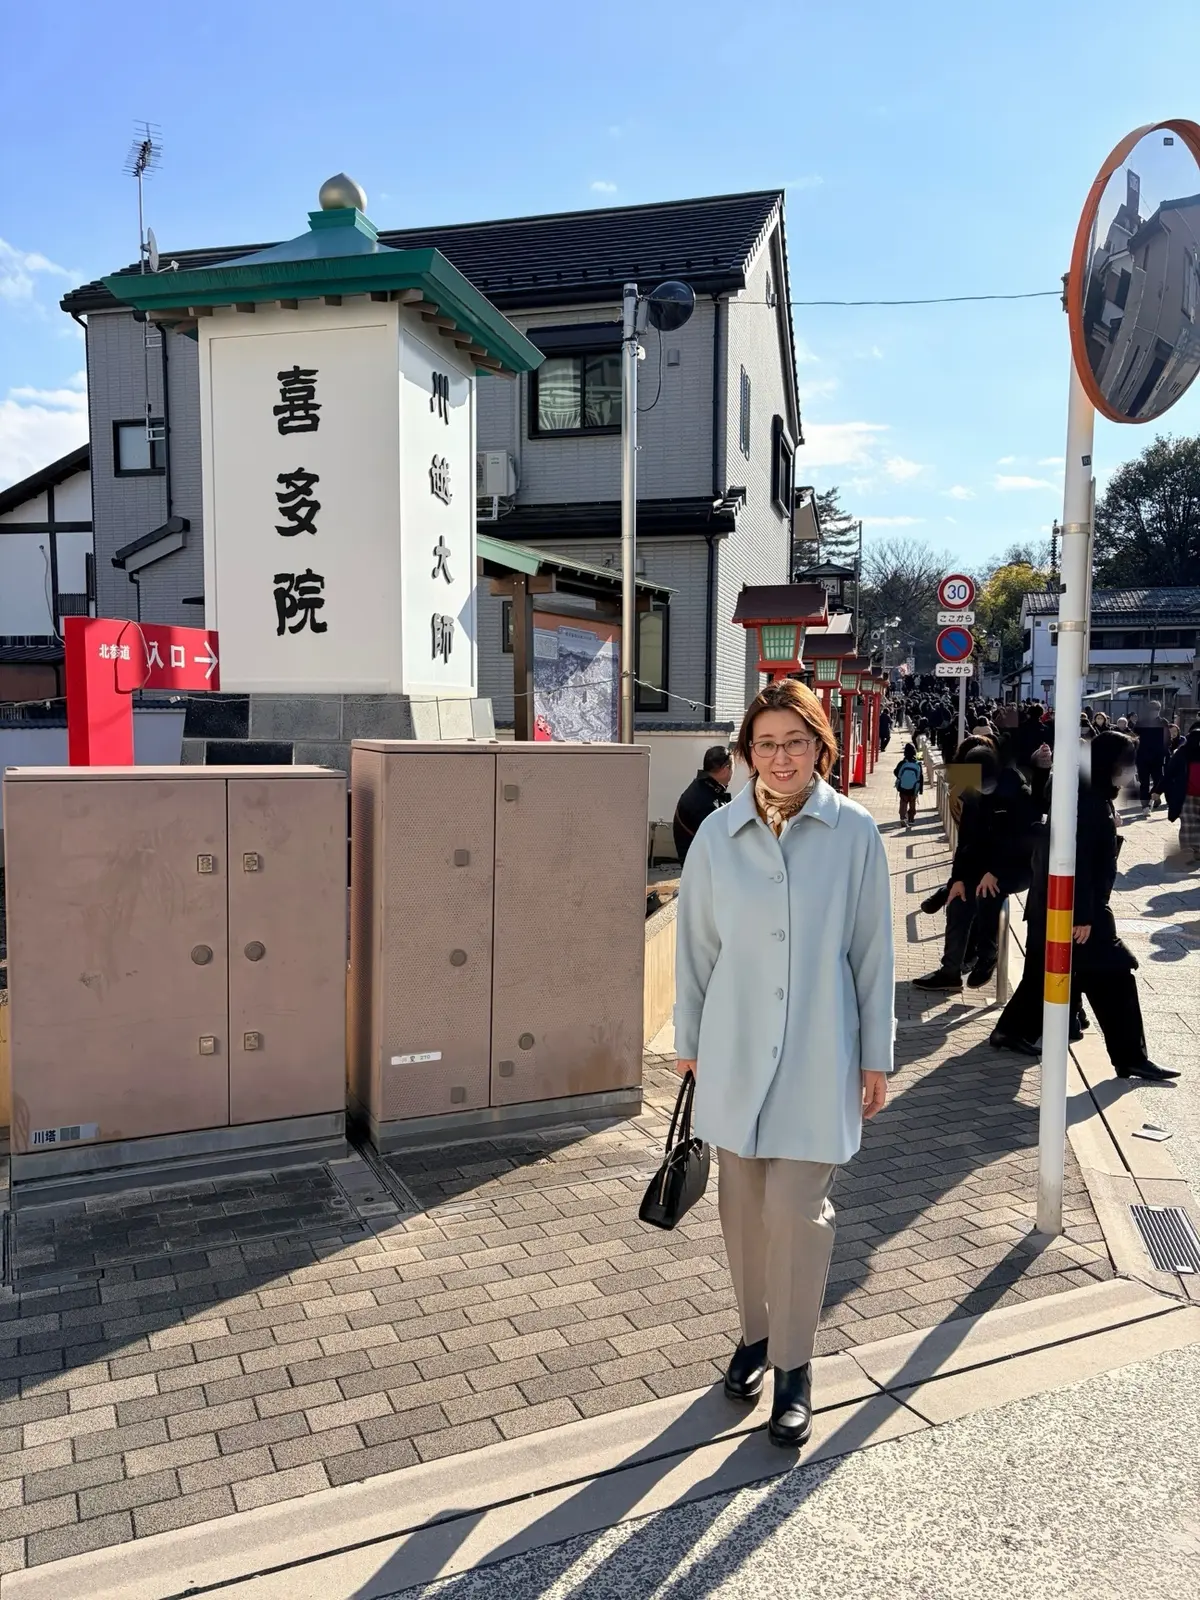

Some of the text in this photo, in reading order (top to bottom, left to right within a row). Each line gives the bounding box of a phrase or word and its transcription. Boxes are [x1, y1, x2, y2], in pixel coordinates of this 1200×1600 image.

[273, 365, 328, 637] 喜多院
[947, 584, 967, 599] 30
[939, 615, 972, 623] ここから
[99, 641, 186, 668] 北参道 入口
[938, 666, 971, 674] ここから
[34, 1130, 56, 1143] 川塔
